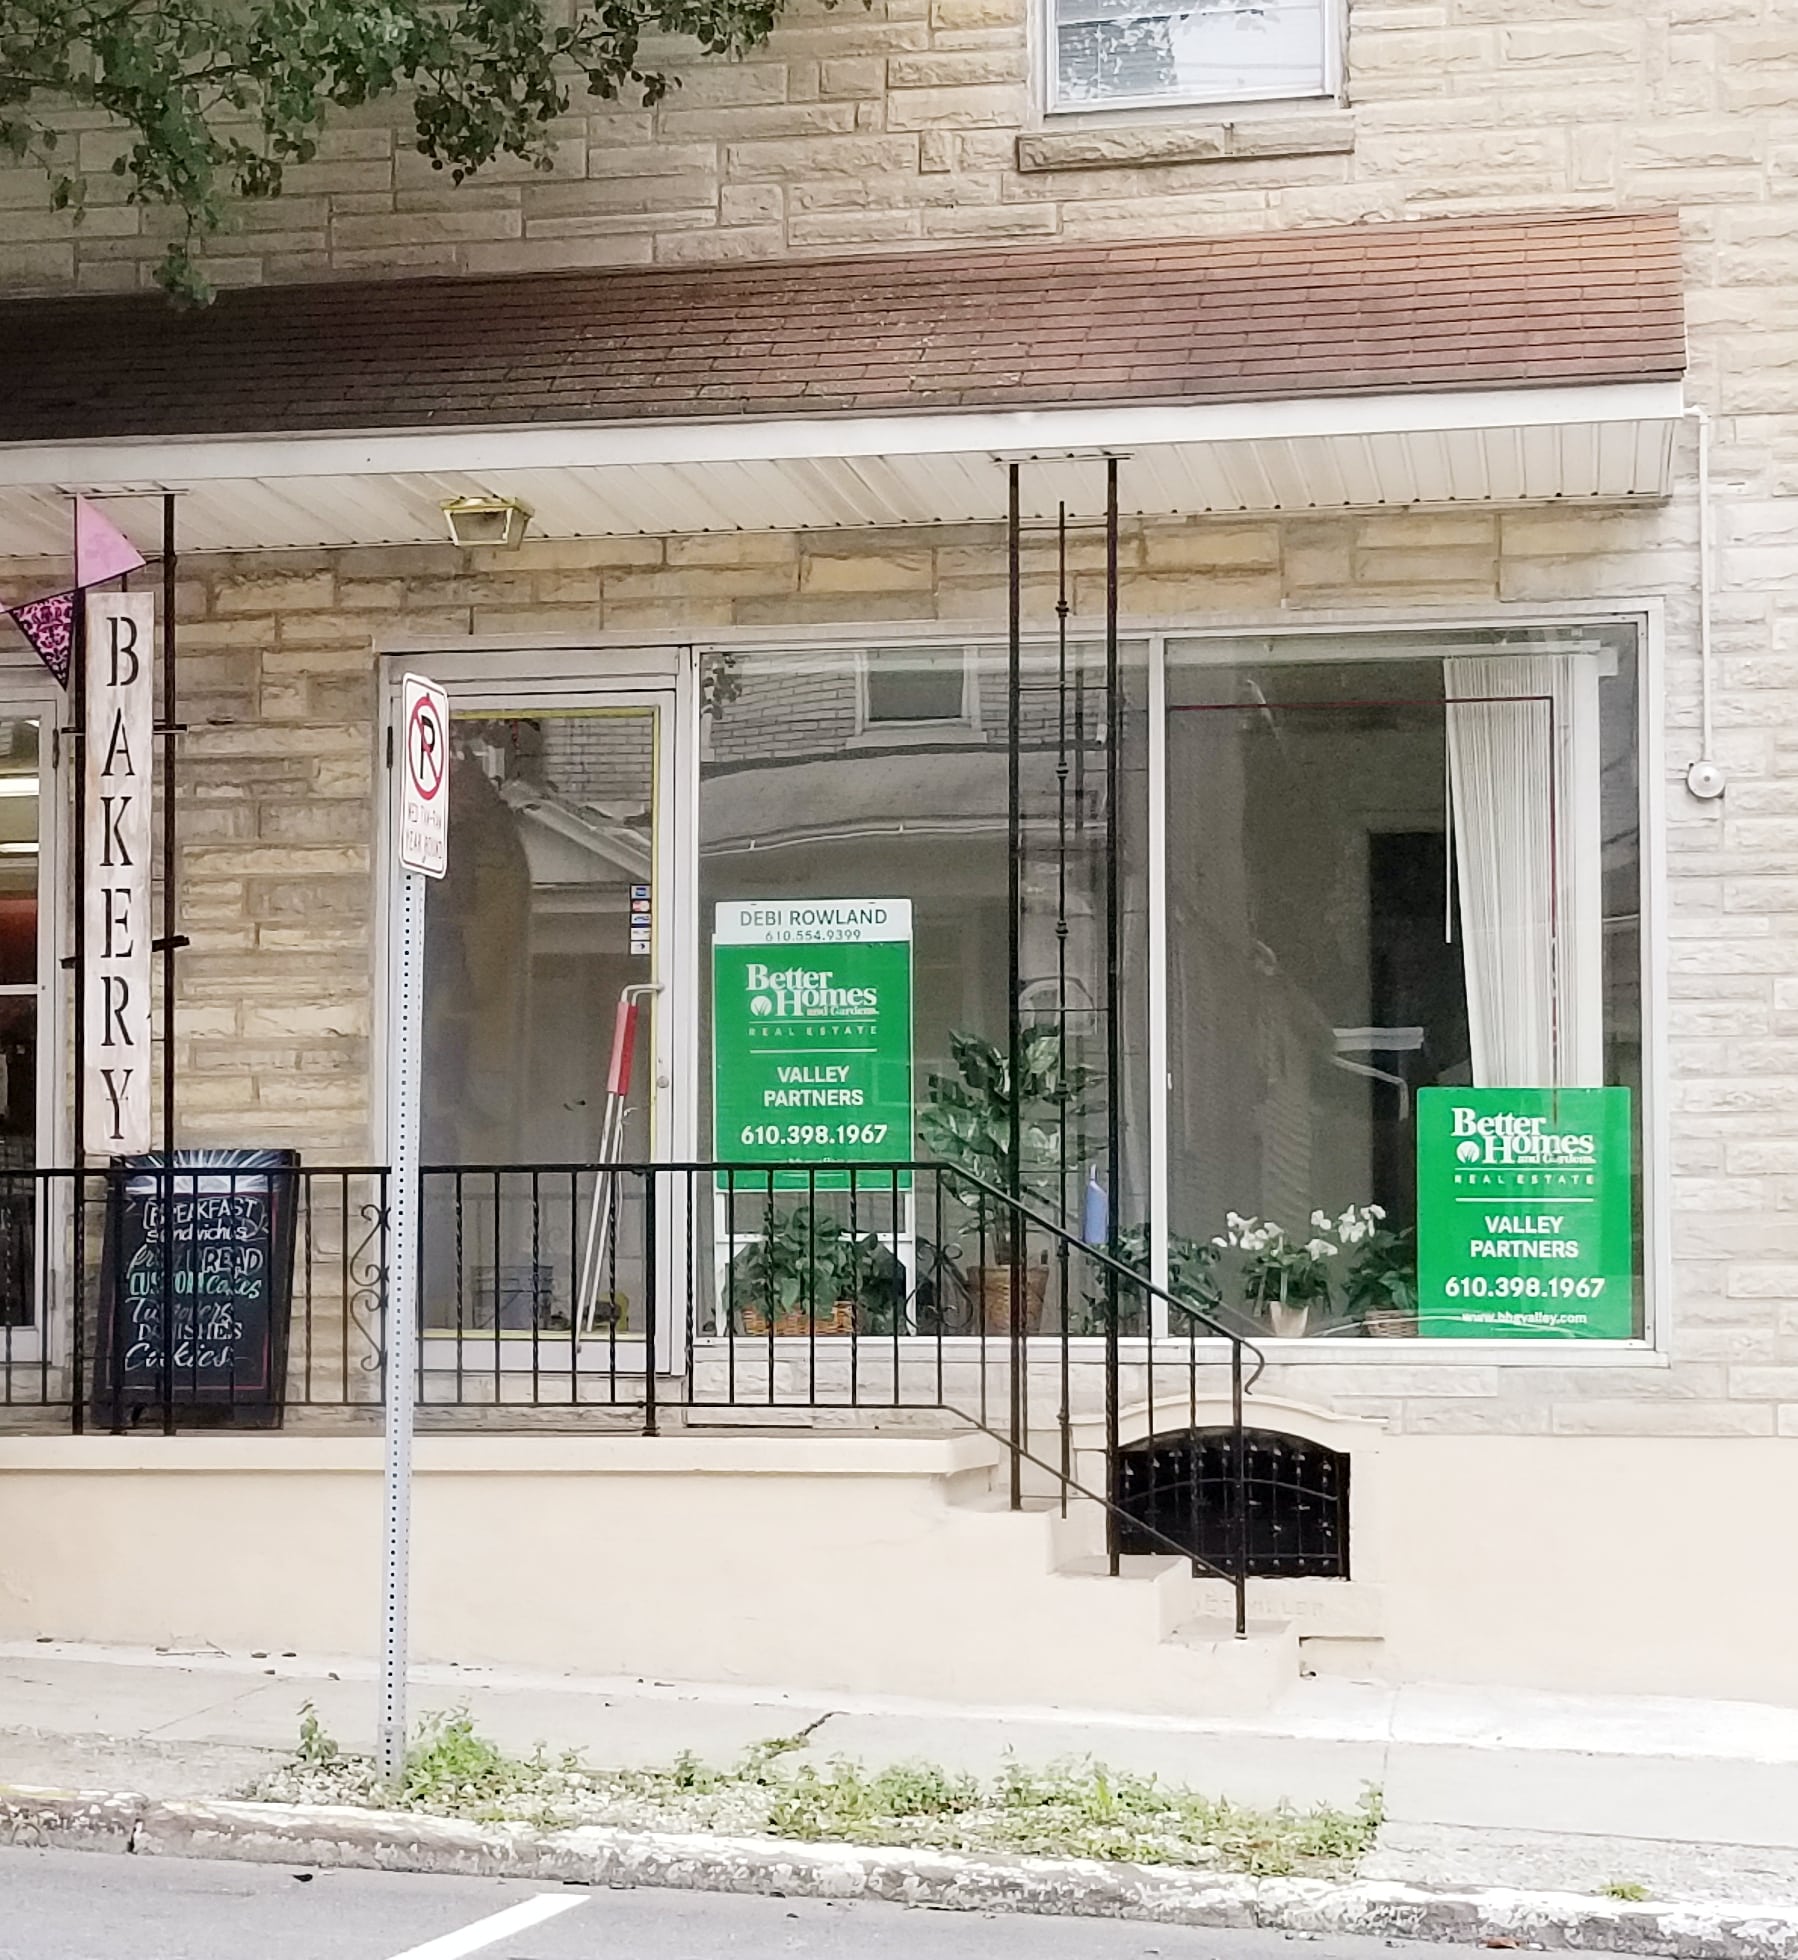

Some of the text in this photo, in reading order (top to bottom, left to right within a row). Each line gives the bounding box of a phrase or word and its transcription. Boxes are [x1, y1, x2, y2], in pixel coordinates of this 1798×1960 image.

[99, 615, 139, 1140] BAKERY
[740, 908, 888, 927] DEBI ROWLAND
[765, 929, 862, 943] 610.554.9399
[745, 963, 834, 991] Better
[775, 987, 878, 1017] Homes
[806, 1006, 828, 1016] and
[748, 1025, 878, 1037] REAL ESTATE
[776, 1065, 850, 1083] VALLEY
[763, 1088, 865, 1108] PARTNERS
[1450, 1107, 1547, 1137] Better
[740, 1123, 889, 1145] 610.398.1967
[1482, 1133, 1595, 1165] Homes
[1517, 1154, 1540, 1164] and
[1454, 1173, 1595, 1185] REAL ESTATE
[1484, 1215, 1565, 1234] VALLEY
[1470, 1239, 1580, 1259] PARTNERS
[1444, 1276, 1606, 1298] 610.398.1967
